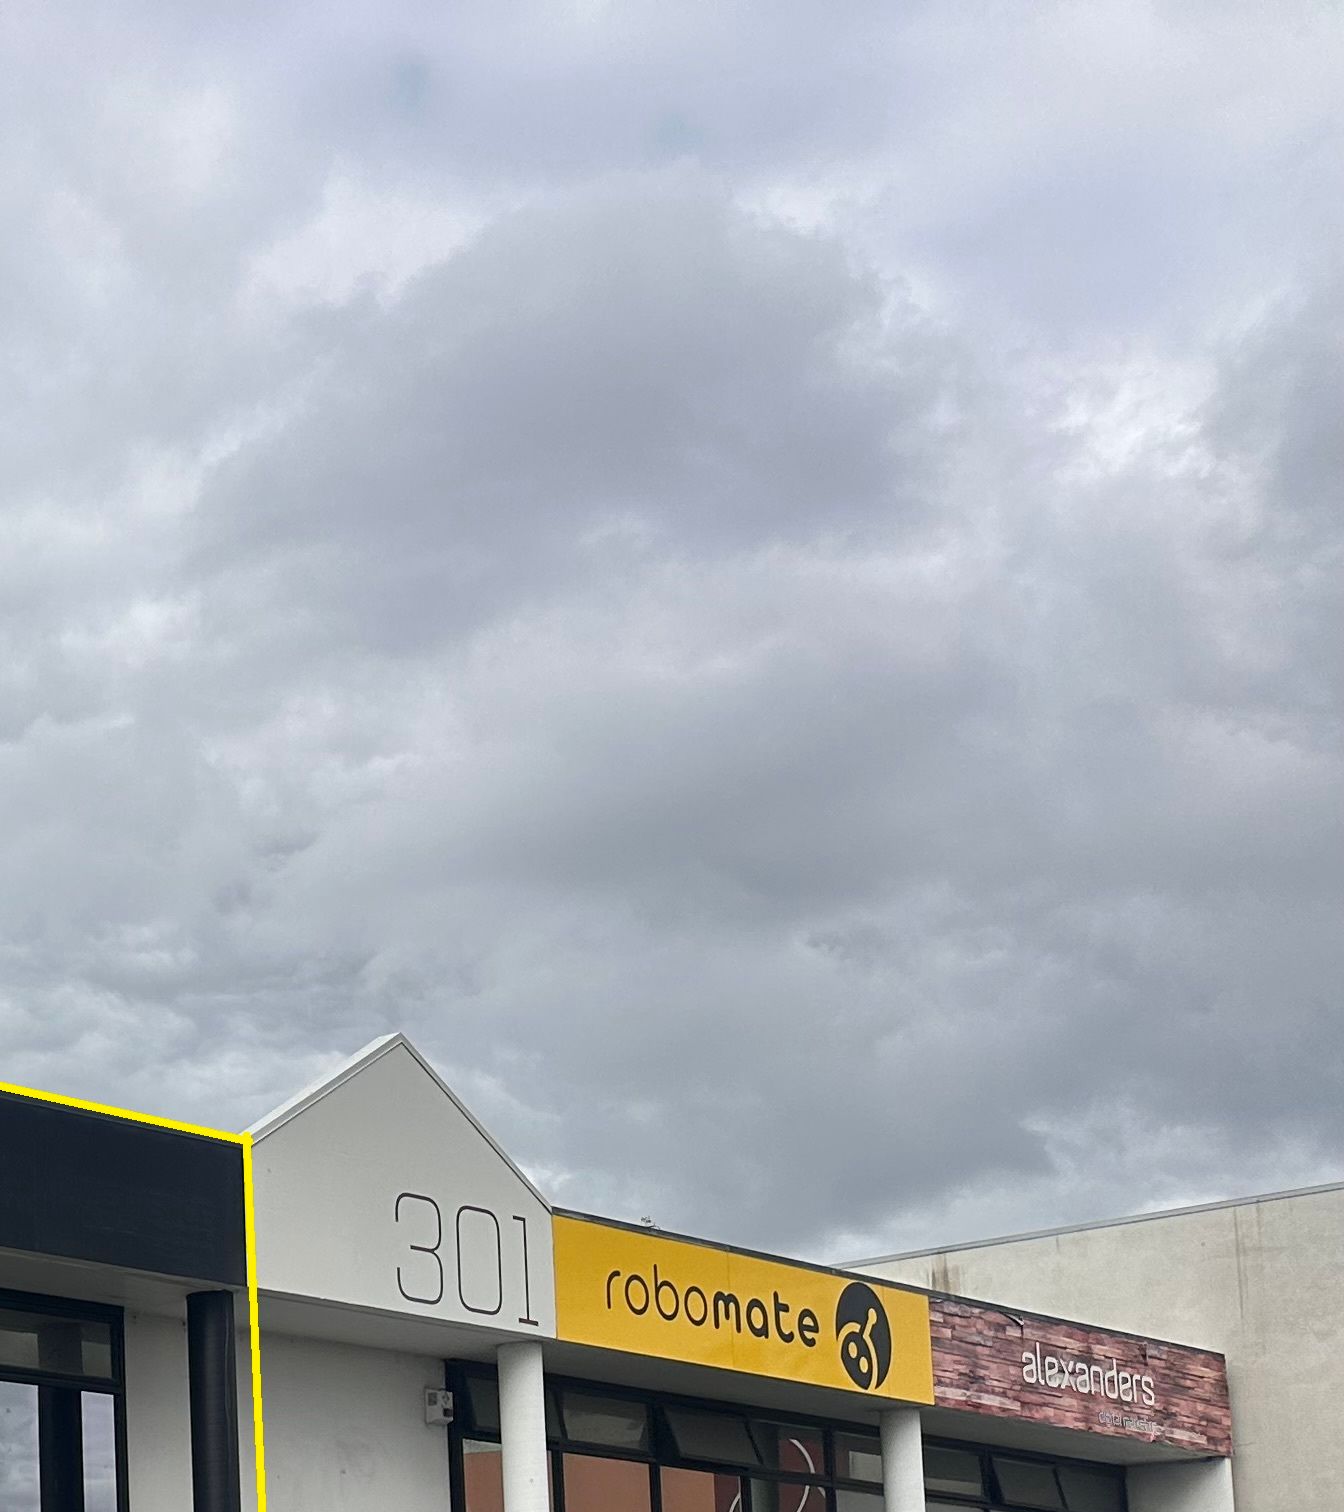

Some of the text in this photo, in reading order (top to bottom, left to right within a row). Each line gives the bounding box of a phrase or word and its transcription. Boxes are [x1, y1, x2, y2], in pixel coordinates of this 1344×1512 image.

[394, 1192, 539, 1327] 301
[605, 1264, 820, 1348] robomate
[1021, 1341, 1155, 1406] alexanders
